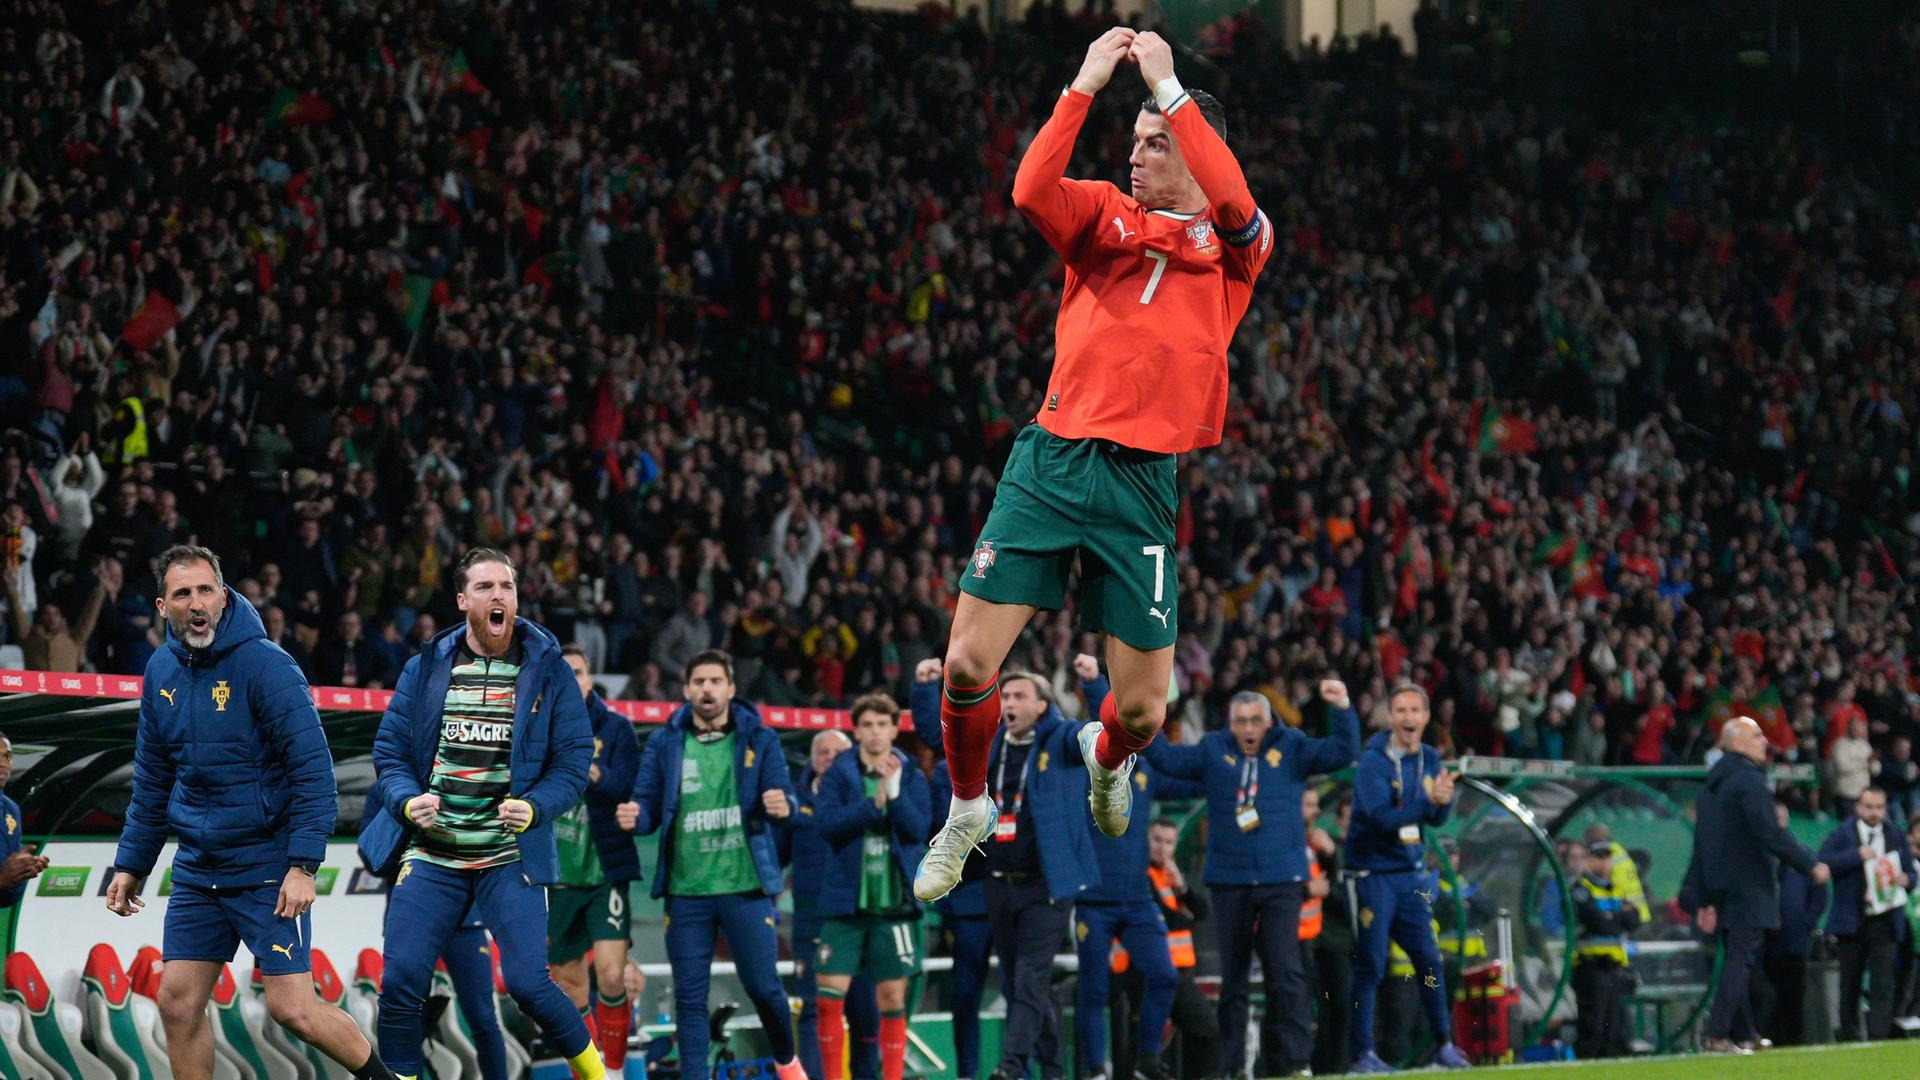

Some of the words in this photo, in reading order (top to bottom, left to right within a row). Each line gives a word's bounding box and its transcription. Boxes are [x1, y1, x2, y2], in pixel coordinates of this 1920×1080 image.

[1139, 248, 1168, 305] 7
[1143, 545, 1166, 602] 7
[459, 721, 513, 742] SAGRE
[608, 887, 624, 917] 6
[892, 923, 915, 955] 11
